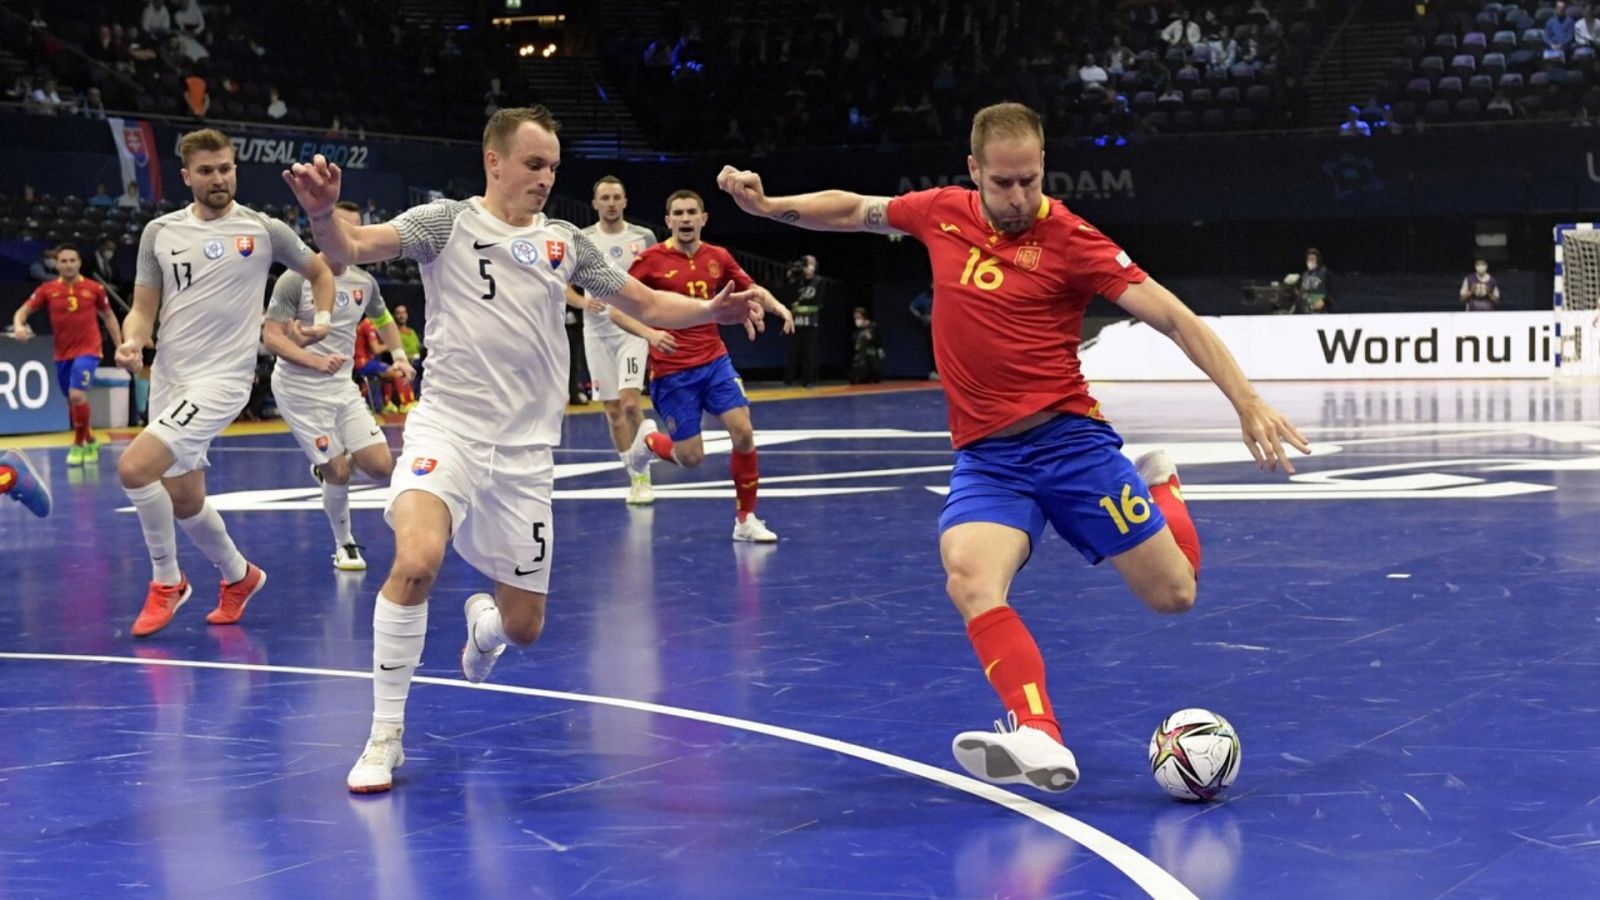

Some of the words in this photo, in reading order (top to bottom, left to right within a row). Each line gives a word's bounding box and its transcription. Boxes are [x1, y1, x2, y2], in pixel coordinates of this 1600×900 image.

[172, 262, 192, 291] 13
[479, 258, 496, 300] 5
[960, 246, 1004, 291] 16
[66, 296, 78, 312] 3
[1317, 327, 1438, 364] Word
[1456, 335, 1511, 363] nu
[81, 370, 91, 386] 3
[626, 357, 639, 375] 16
[171, 399, 200, 428] 13
[1099, 483, 1151, 535] 16
[532, 522, 546, 562] 5
